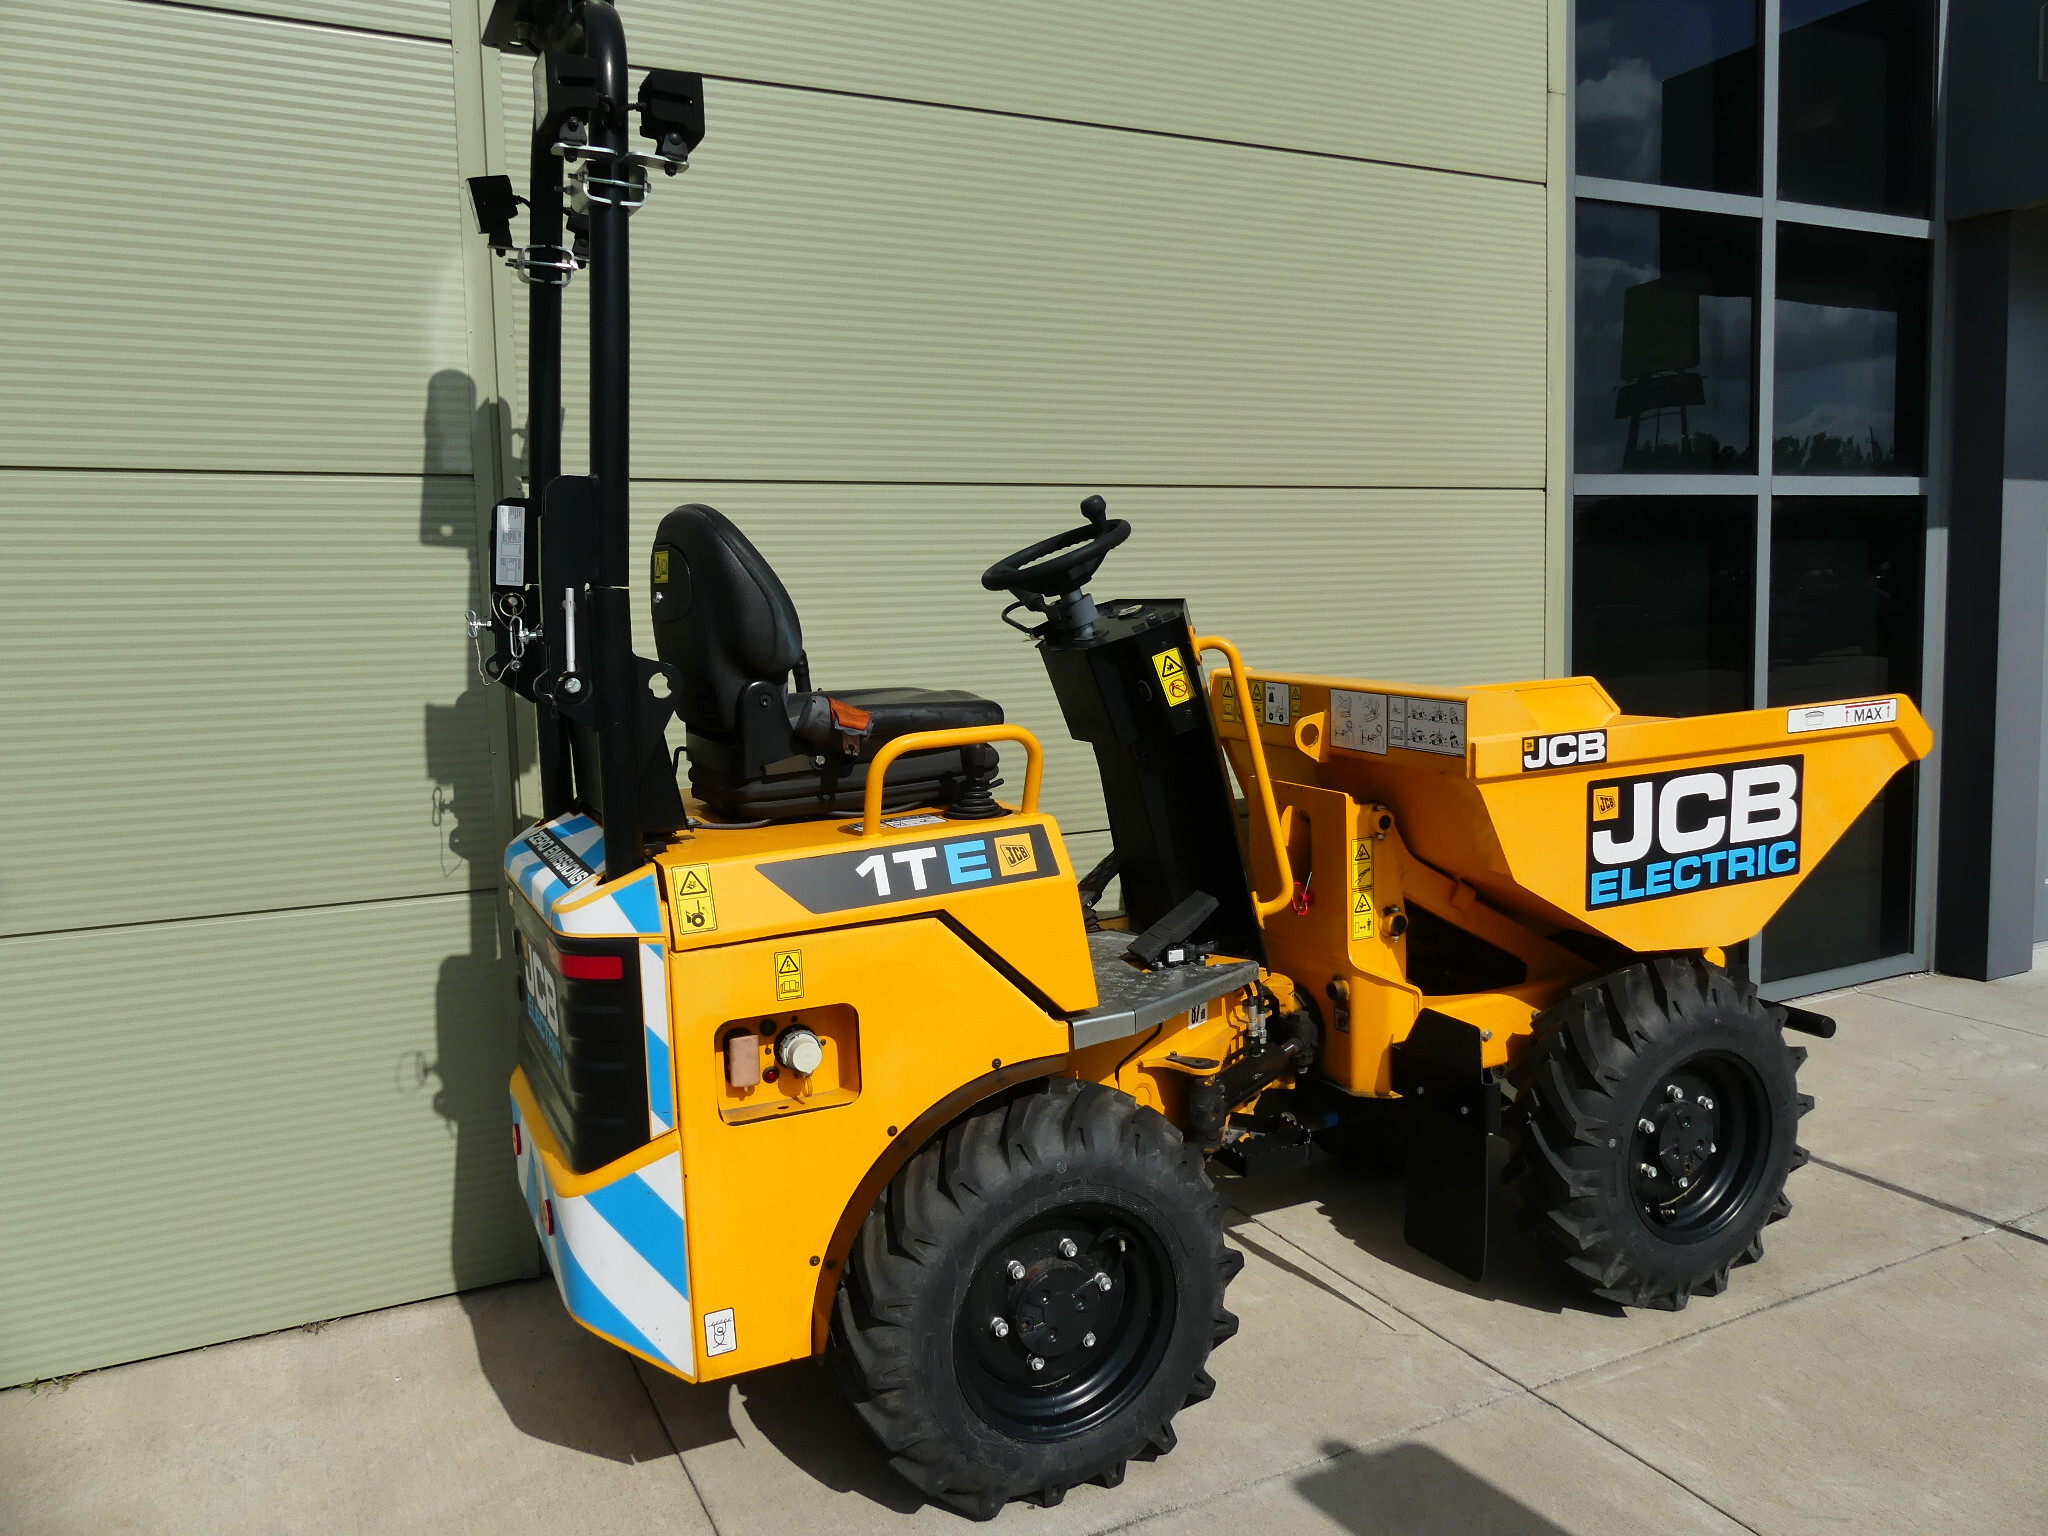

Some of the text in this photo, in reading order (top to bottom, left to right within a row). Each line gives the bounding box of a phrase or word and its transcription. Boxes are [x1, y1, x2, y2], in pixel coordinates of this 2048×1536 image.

[1854, 707, 1883, 723] MAX
[1523, 732, 1606, 769] JCB
[1592, 764, 1798, 865] JCB
[1599, 796, 1615, 812] JCB
[528, 830, 589, 885] ZERO EMISSIONS
[855, 839, 1028, 897] 1TE JCB
[1591, 840, 1796, 905] ELECTRIC
[525, 943, 559, 1038] JCB
